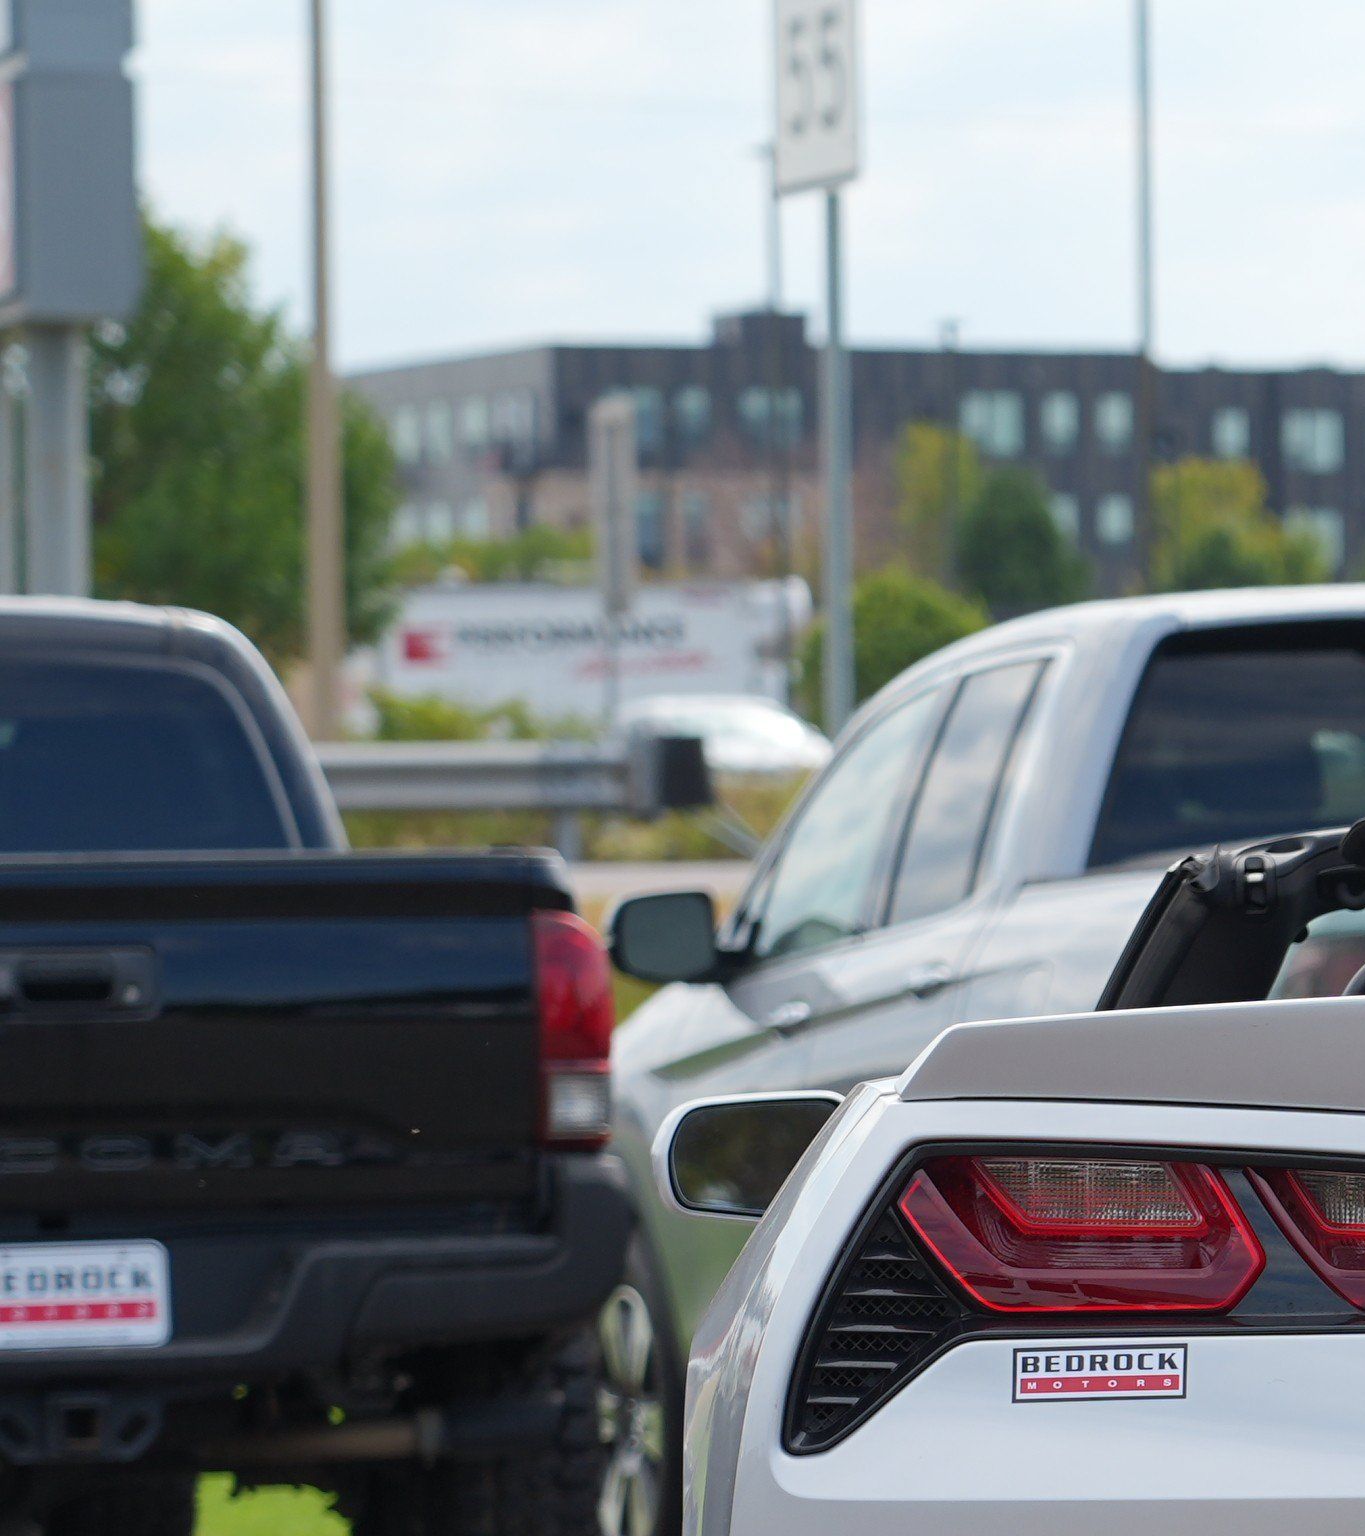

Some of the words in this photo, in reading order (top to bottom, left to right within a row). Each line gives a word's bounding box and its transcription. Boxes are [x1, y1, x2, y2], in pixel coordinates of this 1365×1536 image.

[787, 9, 848, 136] 55
[1021, 1352, 1179, 1373] BEDROCK
[1027, 1378, 1173, 1390] MOTORS
